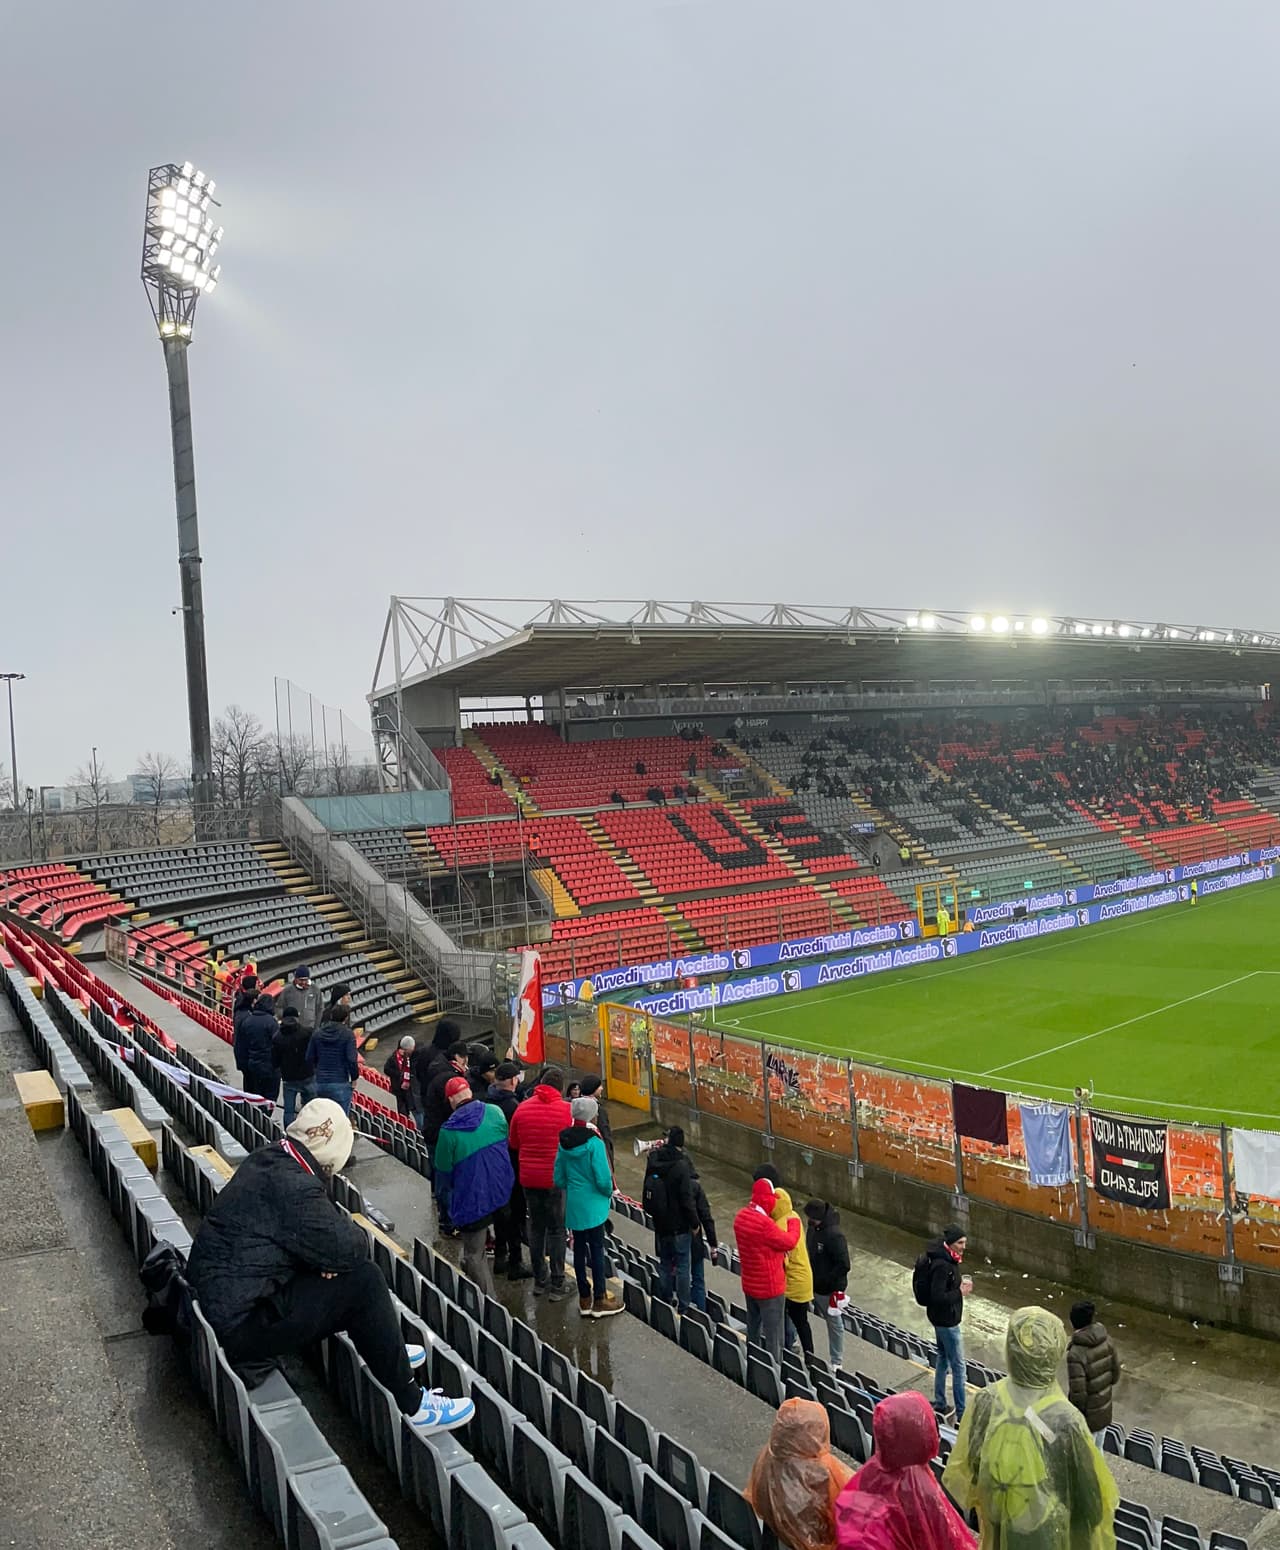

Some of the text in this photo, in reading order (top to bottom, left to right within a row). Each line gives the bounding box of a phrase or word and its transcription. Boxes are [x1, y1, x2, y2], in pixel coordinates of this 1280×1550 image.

[1182, 856, 1240, 878] Arvedi Tubi Acciaio
[1260, 849, 1278, 861] Arvedi
[1093, 872, 1164, 898] Arvedi Tubi Acciaio
[1203, 869, 1264, 894] Arvedi Tubi Acciaio
[974, 905, 1008, 923] Arvedi
[1030, 893, 1063, 912] Acciaio
[1100, 890, 1177, 918] Arvedi Tubi Acciaio
[779, 927, 897, 960] Arvedi Tubi Acciaio
[980, 914, 1075, 948] Arvedi Tubi Acciaio
[594, 956, 729, 993] Arvedi Tubi Acciaio
[818, 944, 939, 984] Arvedi Tubi Acciaio
[633, 978, 779, 1017] Arvedi Tubi Acciaio
